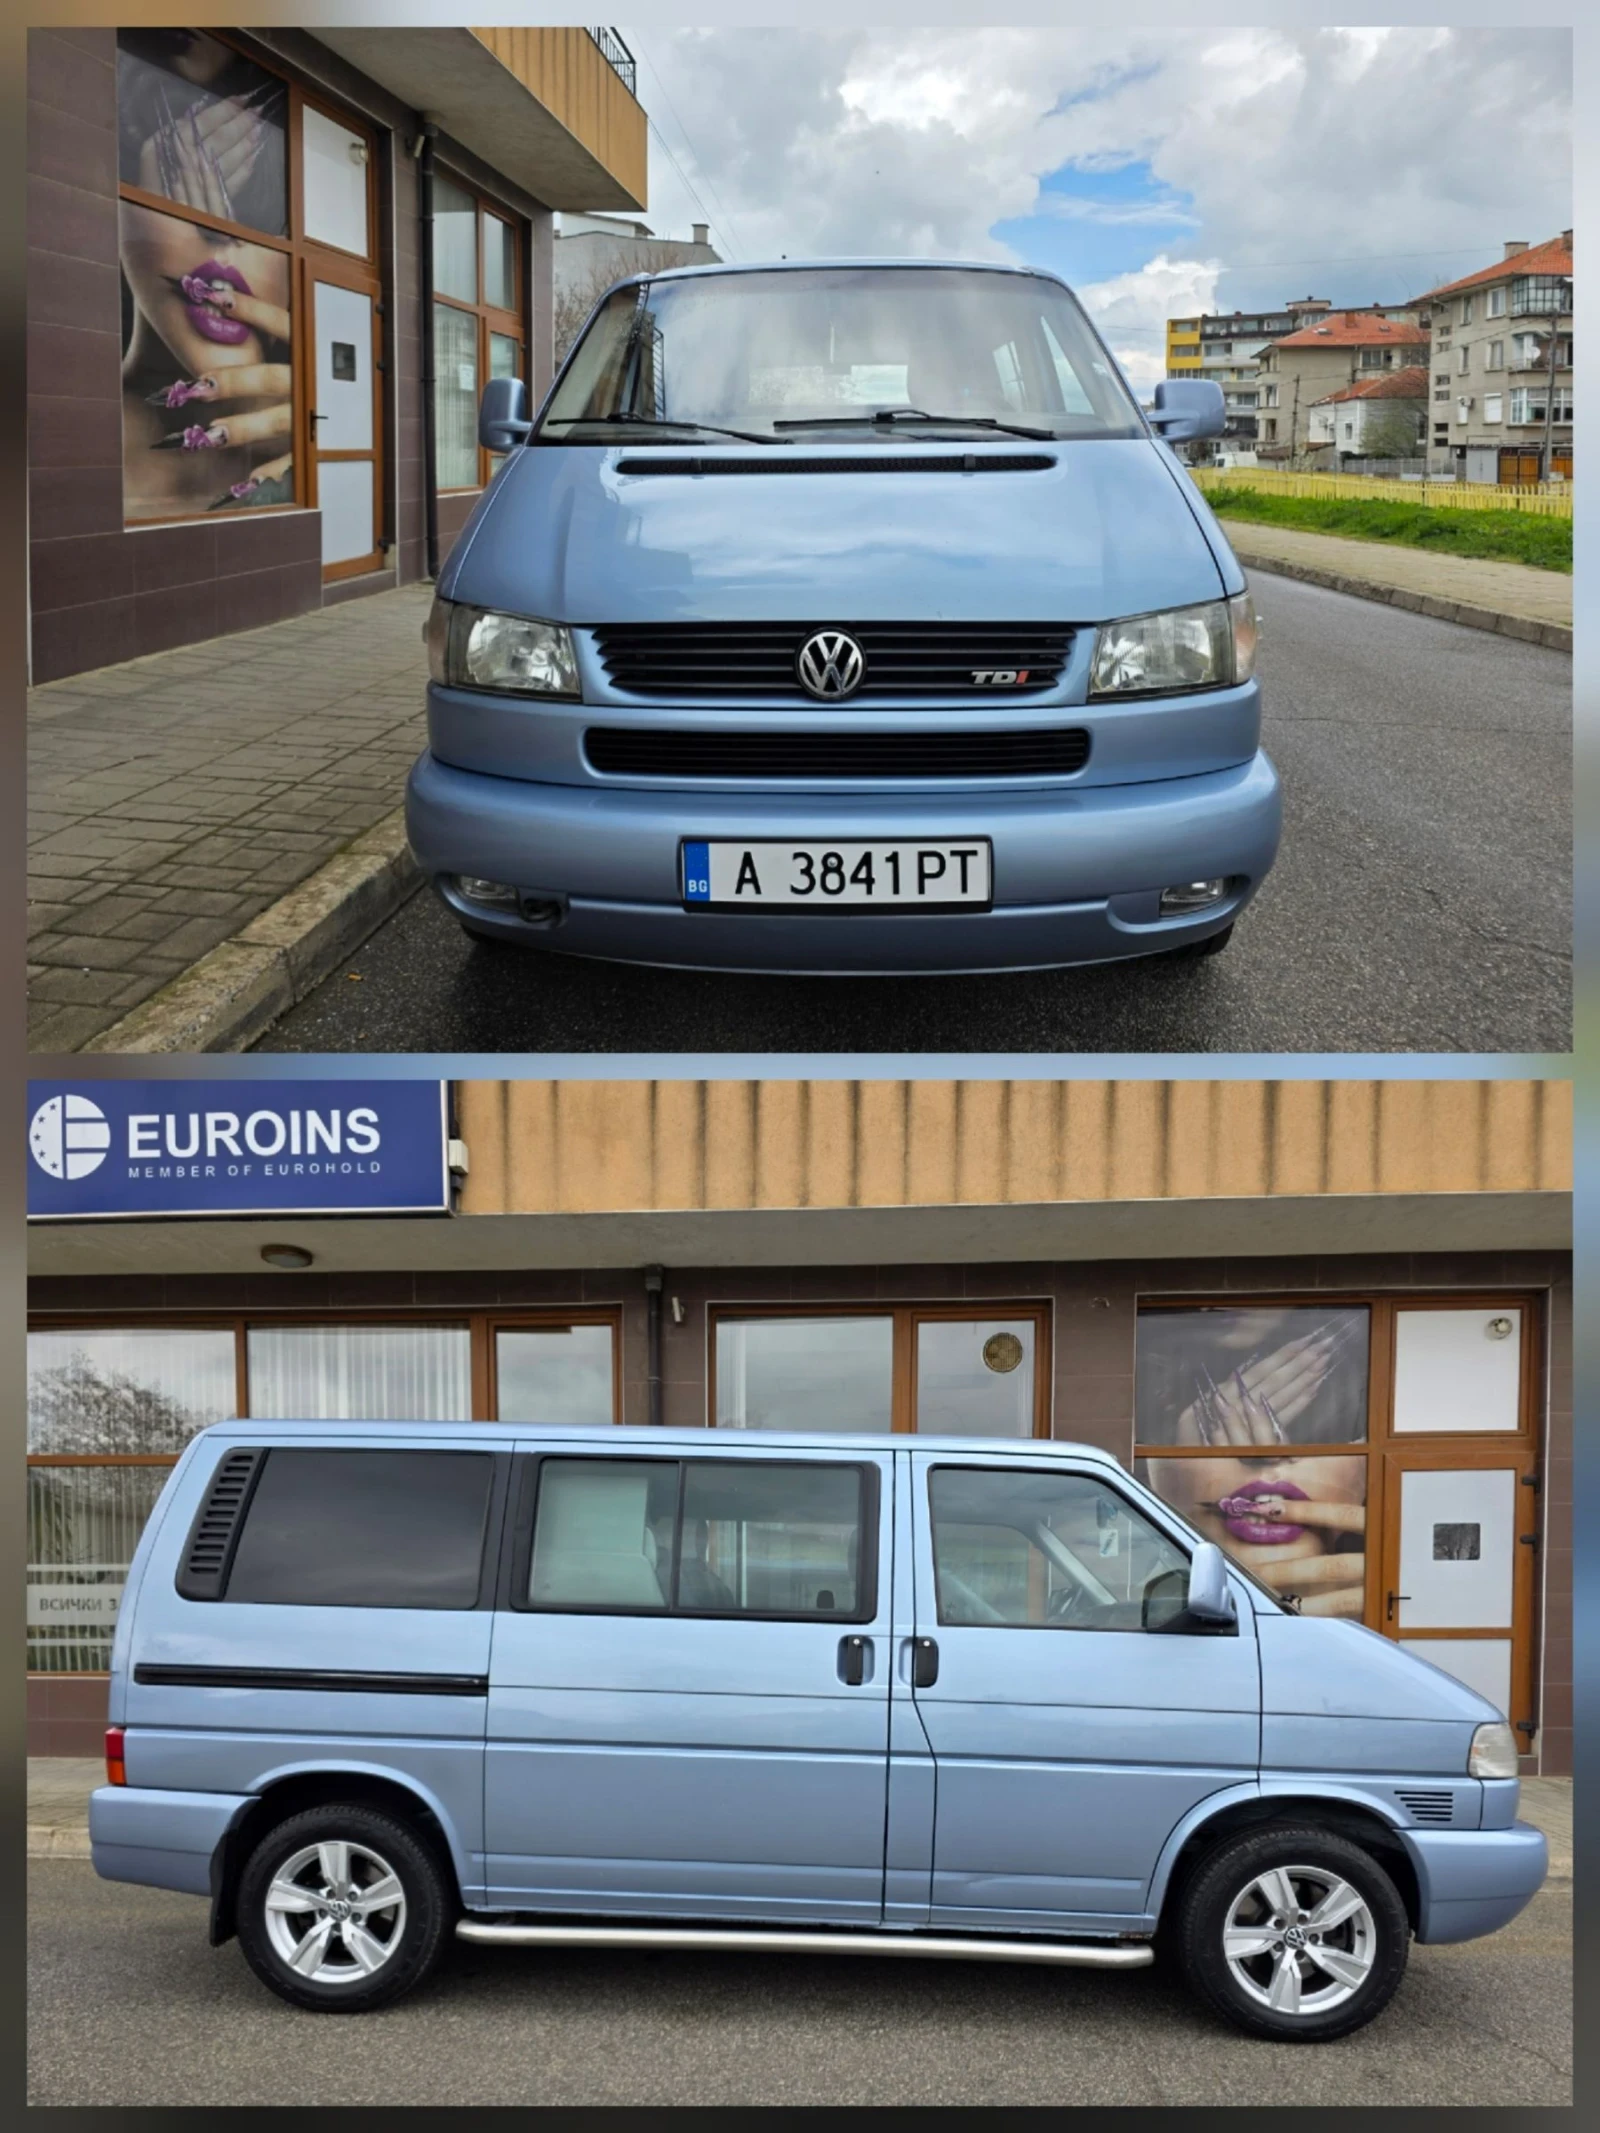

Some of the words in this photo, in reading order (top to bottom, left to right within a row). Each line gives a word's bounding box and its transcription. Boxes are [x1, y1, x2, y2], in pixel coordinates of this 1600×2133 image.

[734, 851, 762, 895] A
[688, 879, 708, 893] BG
[127, 1107, 381, 1159] EUROINS
[128, 1165, 216, 1179] MEMBER
[227, 1164, 253, 1177] OF
[263, 1160, 381, 1176] EUROHOLD
[39, 1597, 103, 1612] ВСИЧКИ
